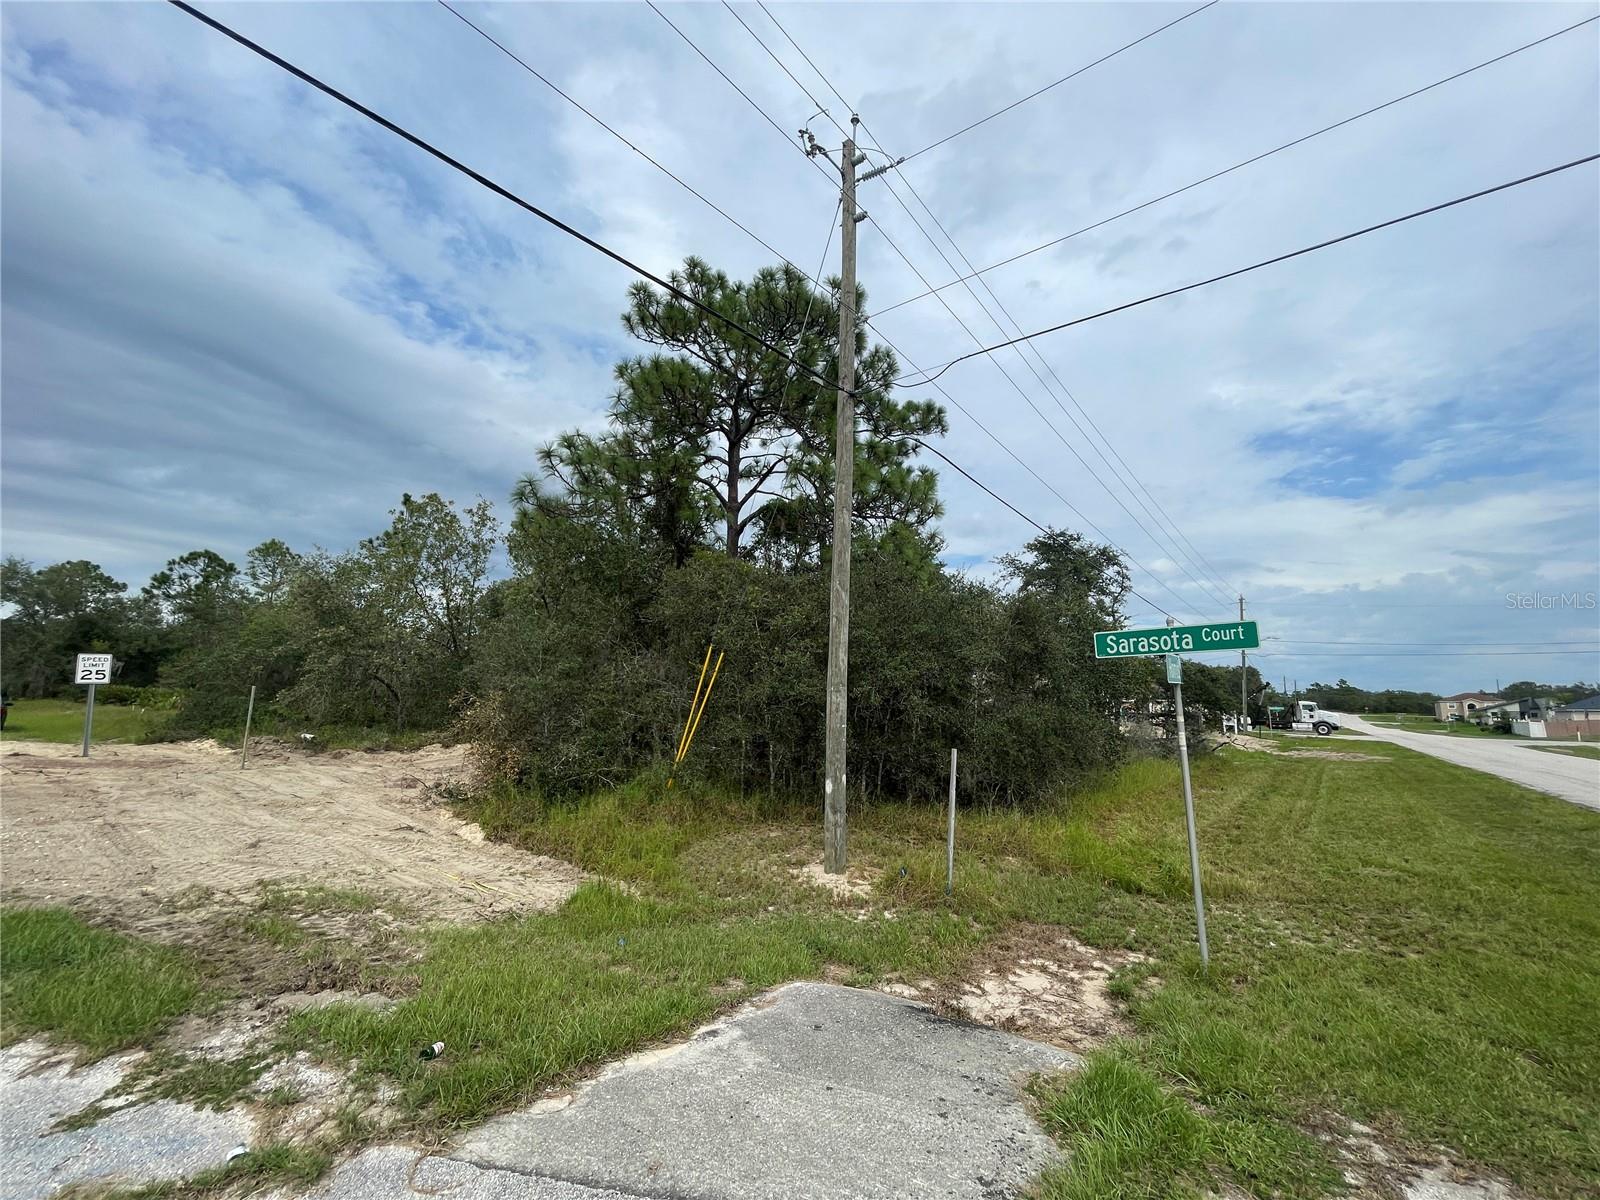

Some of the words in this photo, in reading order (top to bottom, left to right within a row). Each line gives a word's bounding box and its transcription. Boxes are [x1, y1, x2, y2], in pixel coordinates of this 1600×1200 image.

[1106, 631, 1193, 654] Sarasota
[1201, 625, 1244, 641] Court
[80, 670, 106, 680] 25
